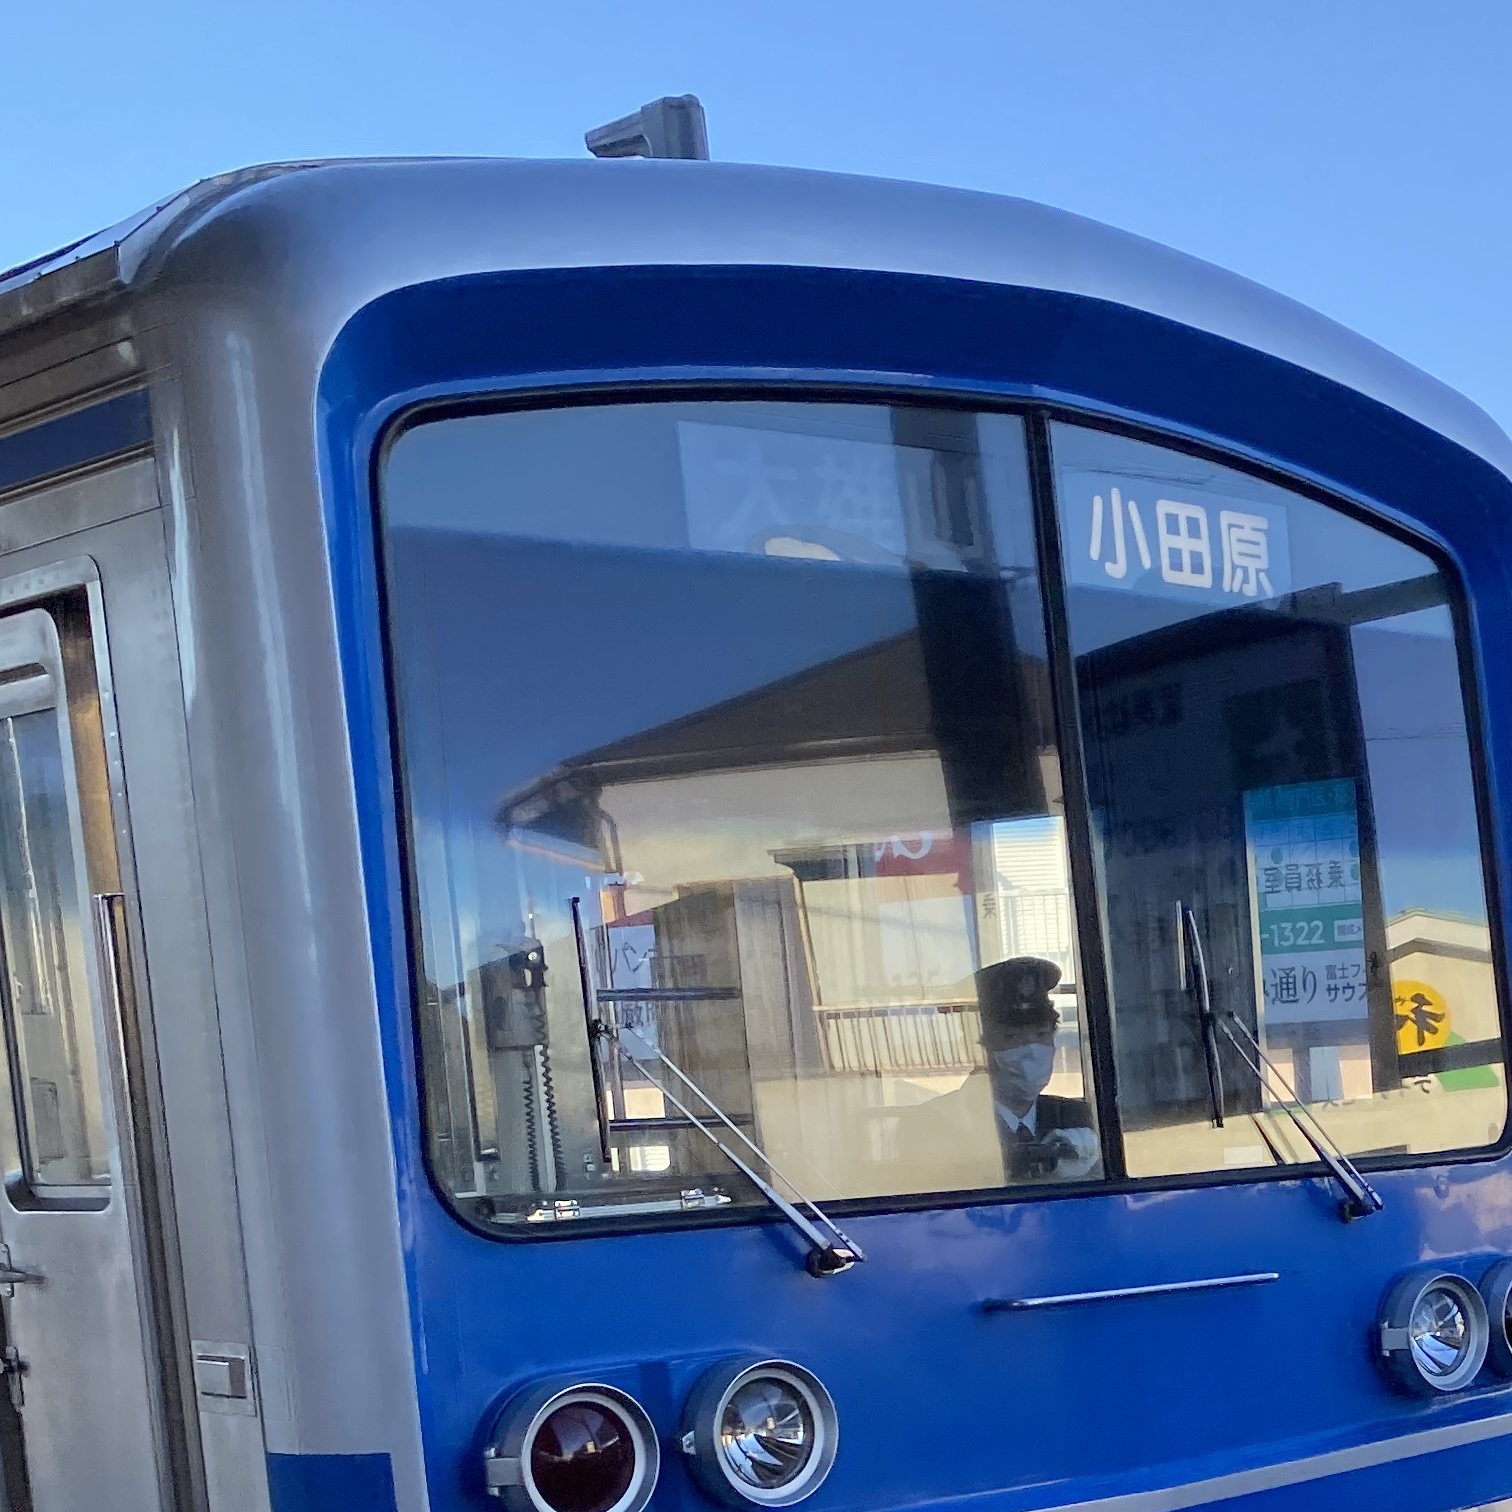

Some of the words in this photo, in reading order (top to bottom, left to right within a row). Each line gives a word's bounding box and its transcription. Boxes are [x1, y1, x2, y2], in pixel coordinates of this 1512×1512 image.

[1089, 487, 1274, 598] 小田原
[1263, 965, 1317, 1005] 通り
